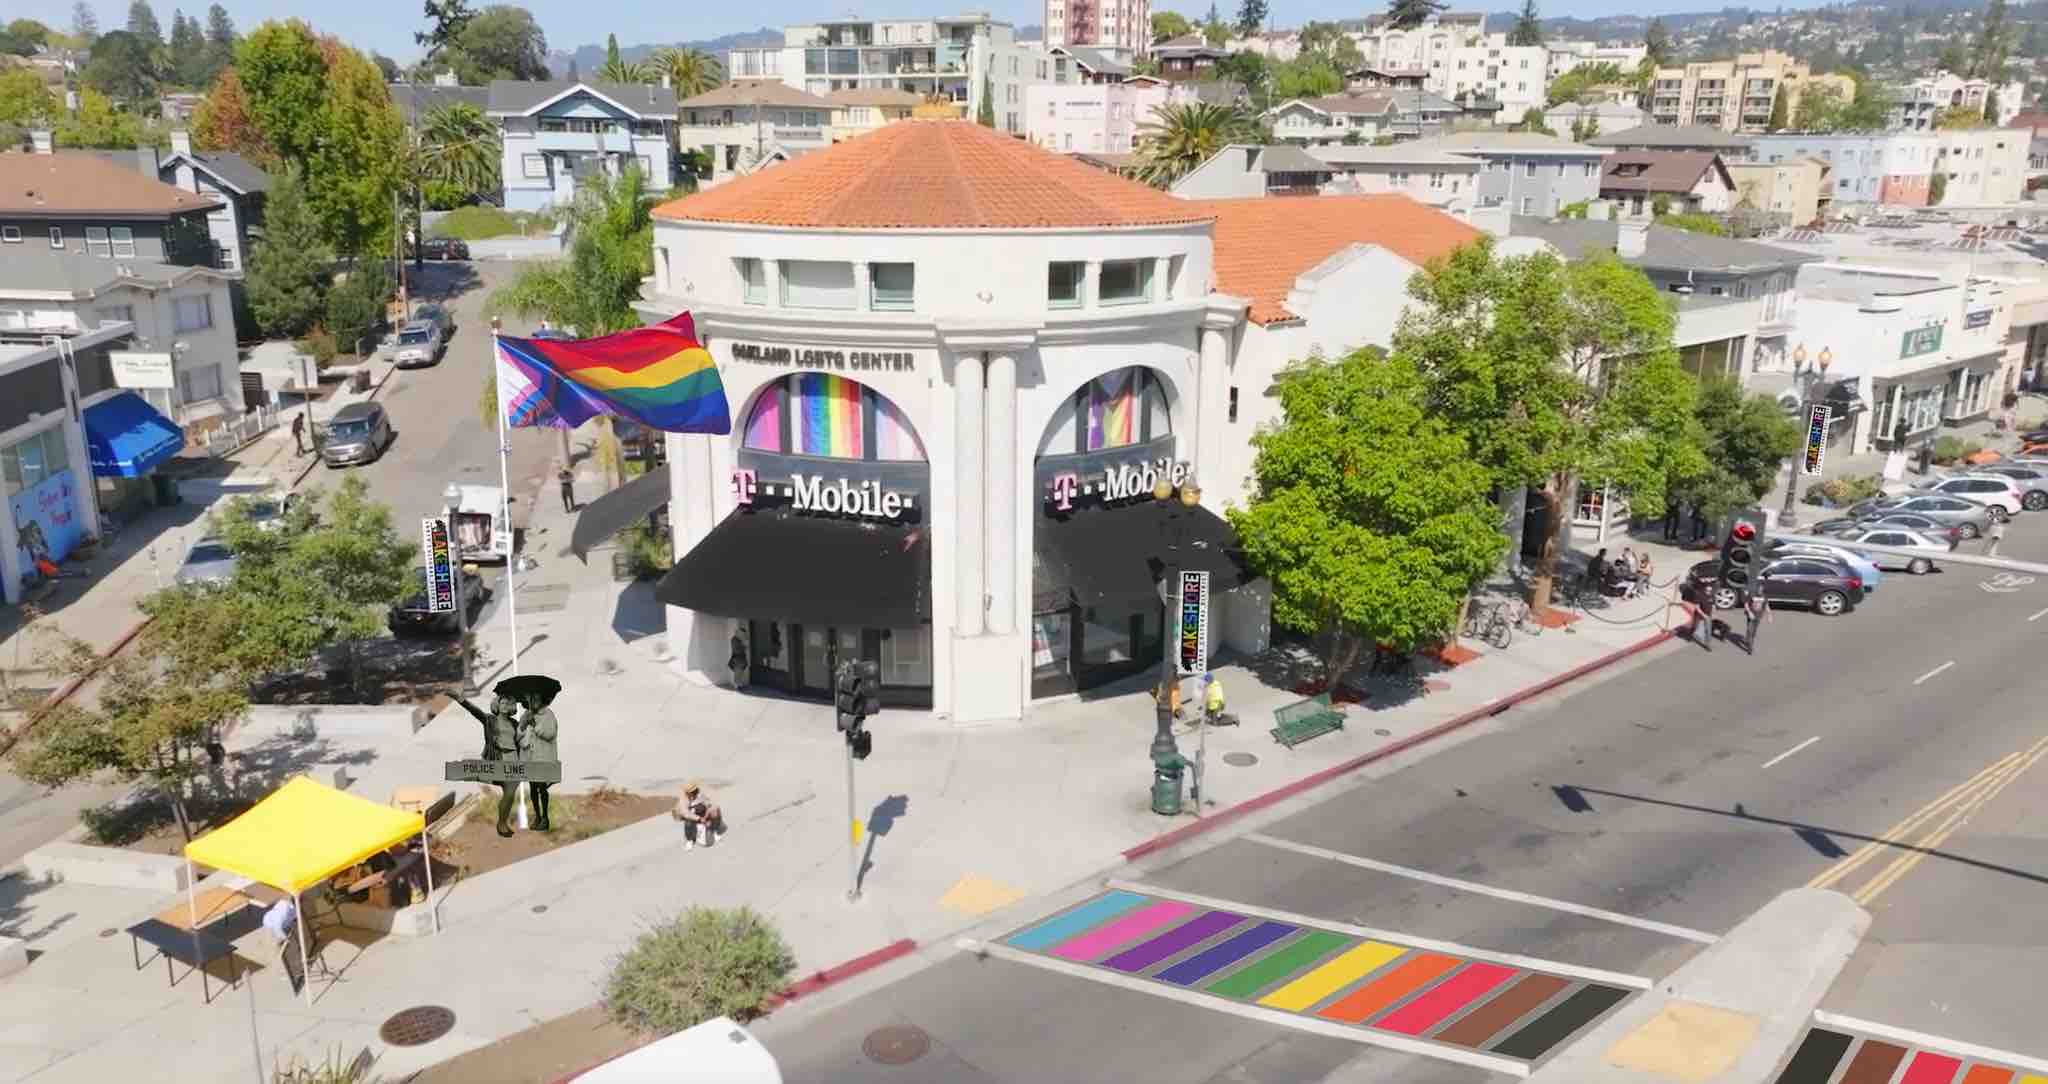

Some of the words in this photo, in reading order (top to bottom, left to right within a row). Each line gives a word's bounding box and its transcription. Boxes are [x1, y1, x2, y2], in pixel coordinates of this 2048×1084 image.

[731, 343, 791, 367] OAKLAND
[795, 349, 845, 370] LGBTQ
[850, 352, 915, 372] CENTER
[432, 530, 452, 609] LAKESHORE
[1183, 574, 1200, 660] LAKESHORE
[463, 764, 495, 774] POLICE
[503, 764, 525, 775] LINE
